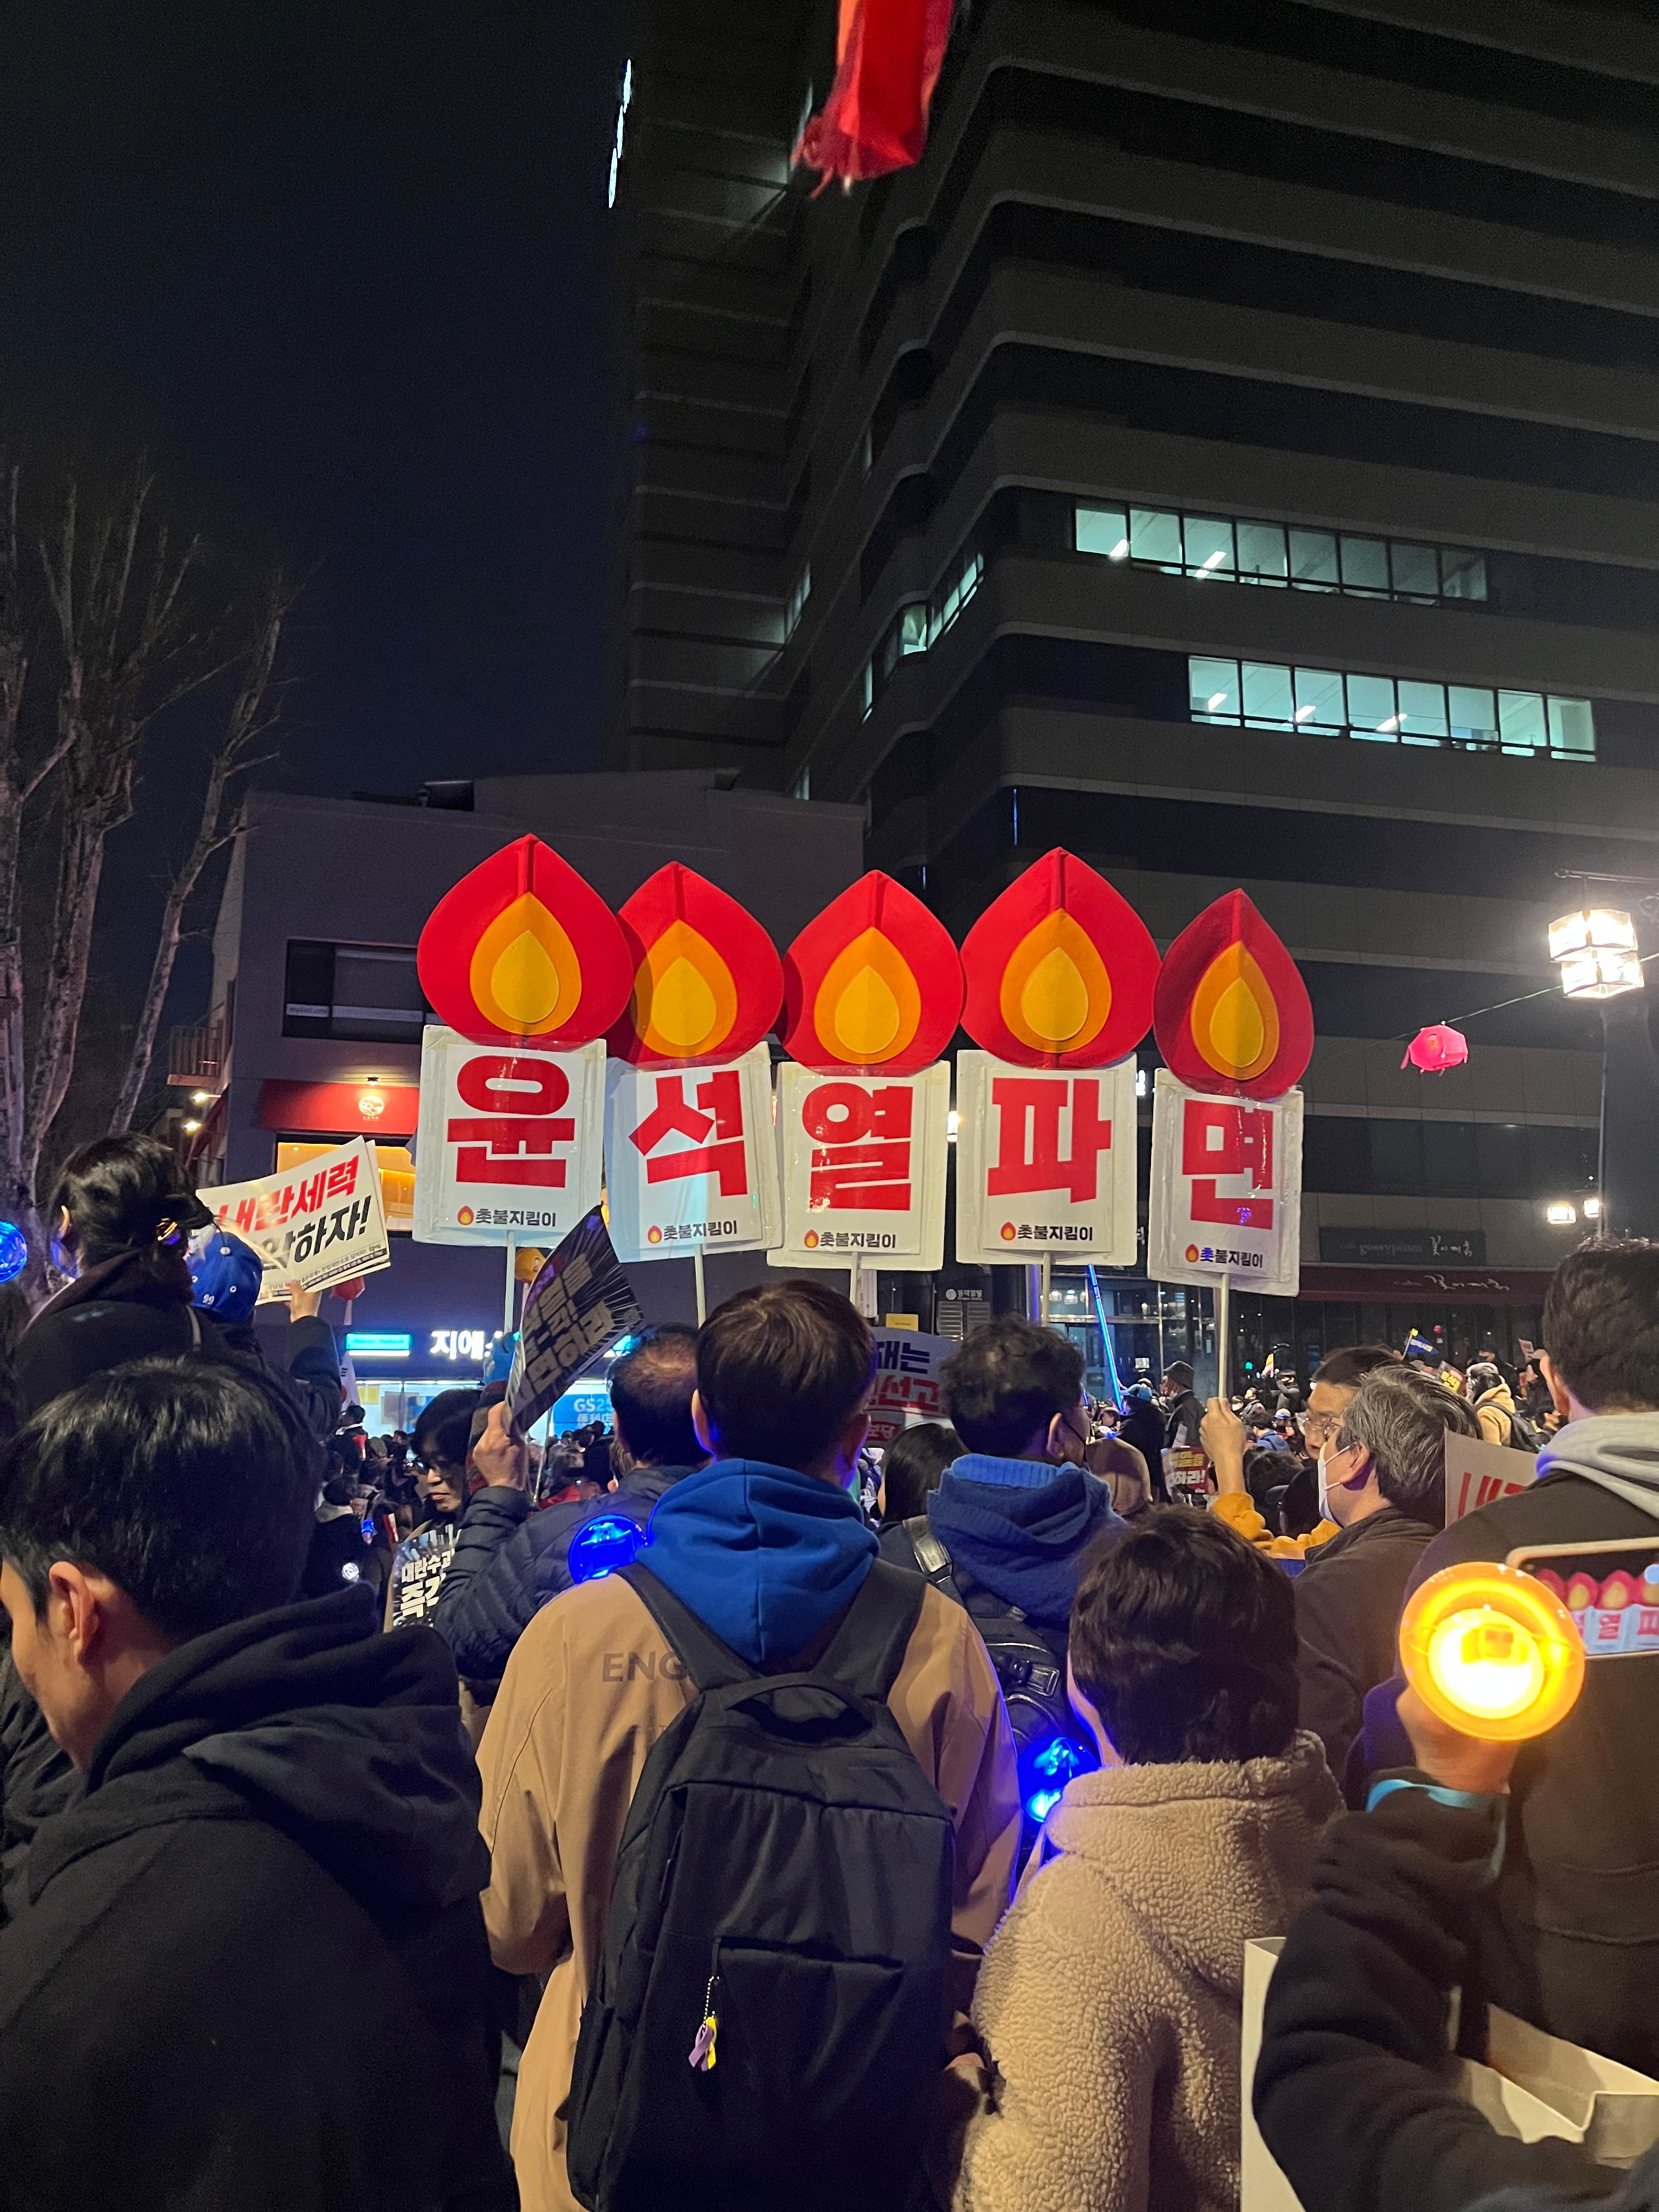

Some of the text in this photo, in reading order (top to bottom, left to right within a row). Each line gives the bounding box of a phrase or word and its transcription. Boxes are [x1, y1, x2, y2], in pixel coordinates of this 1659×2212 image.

[447, 1054, 575, 1188] 윤
[628, 1070, 748, 1197] 석
[802, 1081, 913, 1211] 열
[988, 1077, 1111, 1204] 파
[1182, 1098, 1274, 1230] 면
[476, 1208, 556, 1227] 촛불지킴이
[663, 1220, 737, 1241] 촛불지킴이
[820, 1232, 896, 1249] 촛불지킴이
[1017, 1224, 1093, 1241] 촛불지킴이
[202, 1294, 215, 1305] 99
